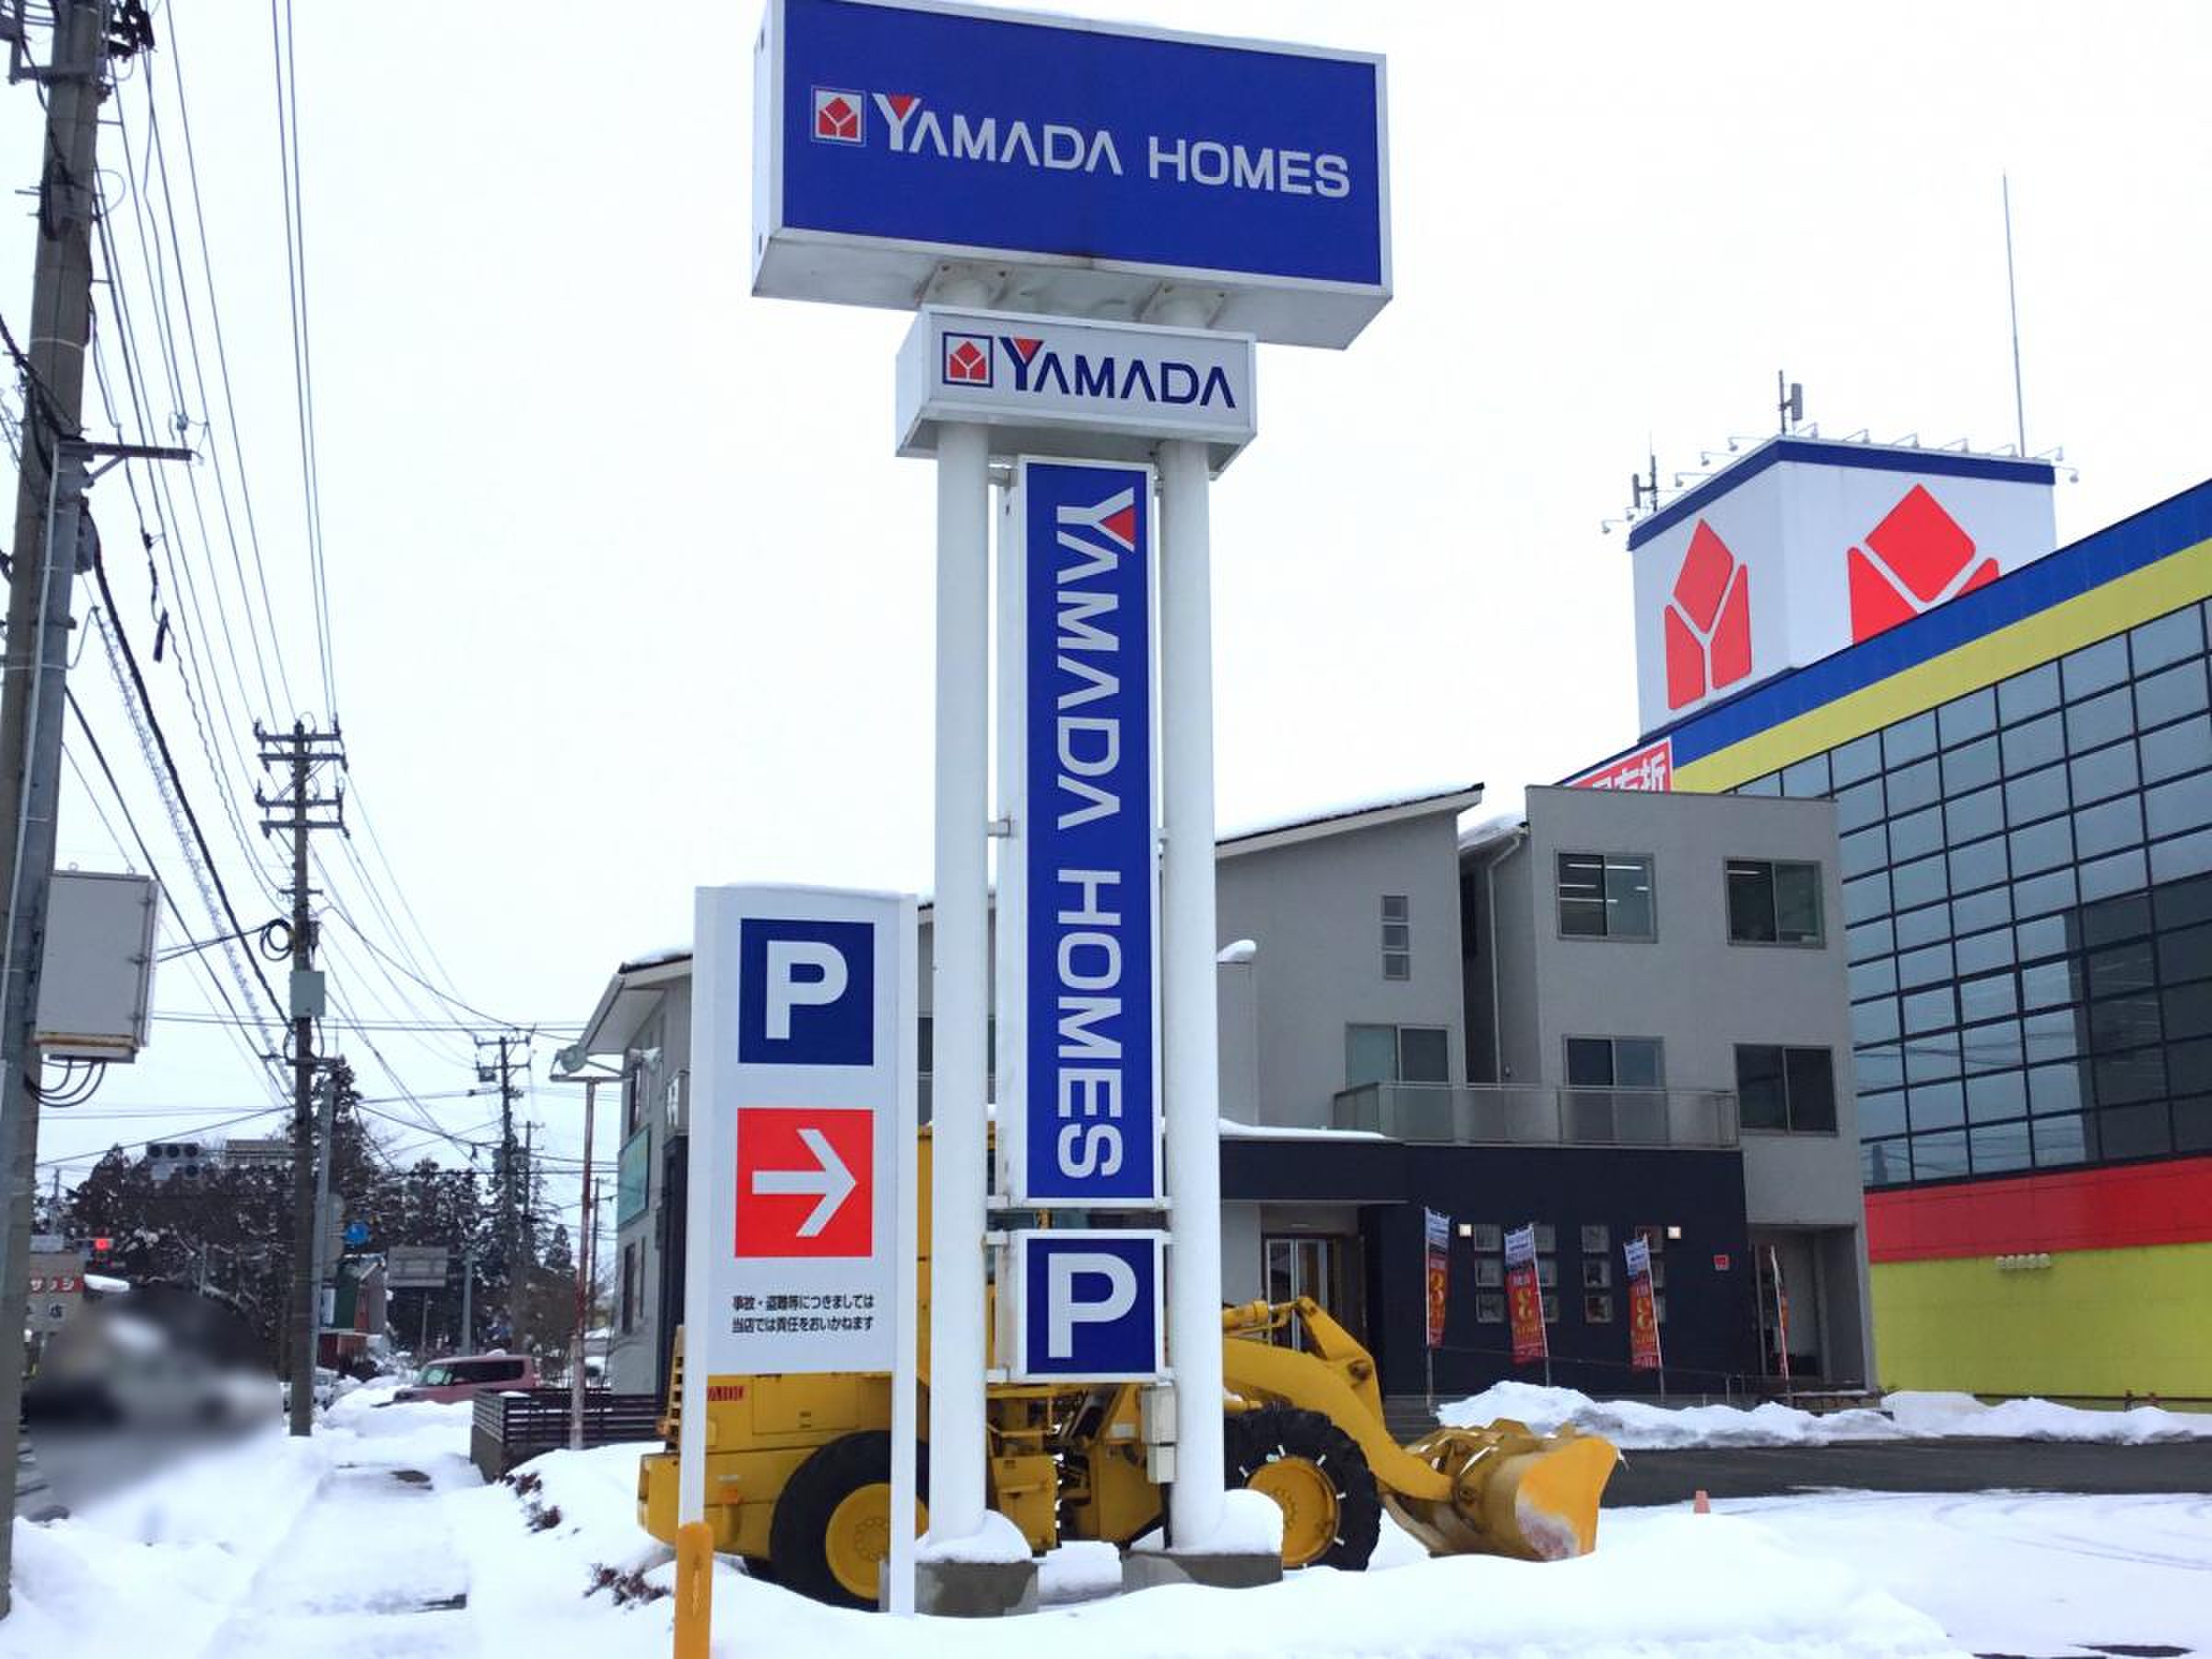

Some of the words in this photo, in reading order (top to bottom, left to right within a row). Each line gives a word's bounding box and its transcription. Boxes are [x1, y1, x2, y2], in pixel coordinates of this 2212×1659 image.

[871, 93, 1123, 175] YAMADA
[1148, 135, 1350, 199] HOMES
[999, 337, 1236, 408] YAMADA
[1056, 487, 1135, 830] YAMADA
[766, 939, 849, 1041] P
[1056, 868, 1124, 1179] HOMES
[1047, 1252, 1138, 1359] P
